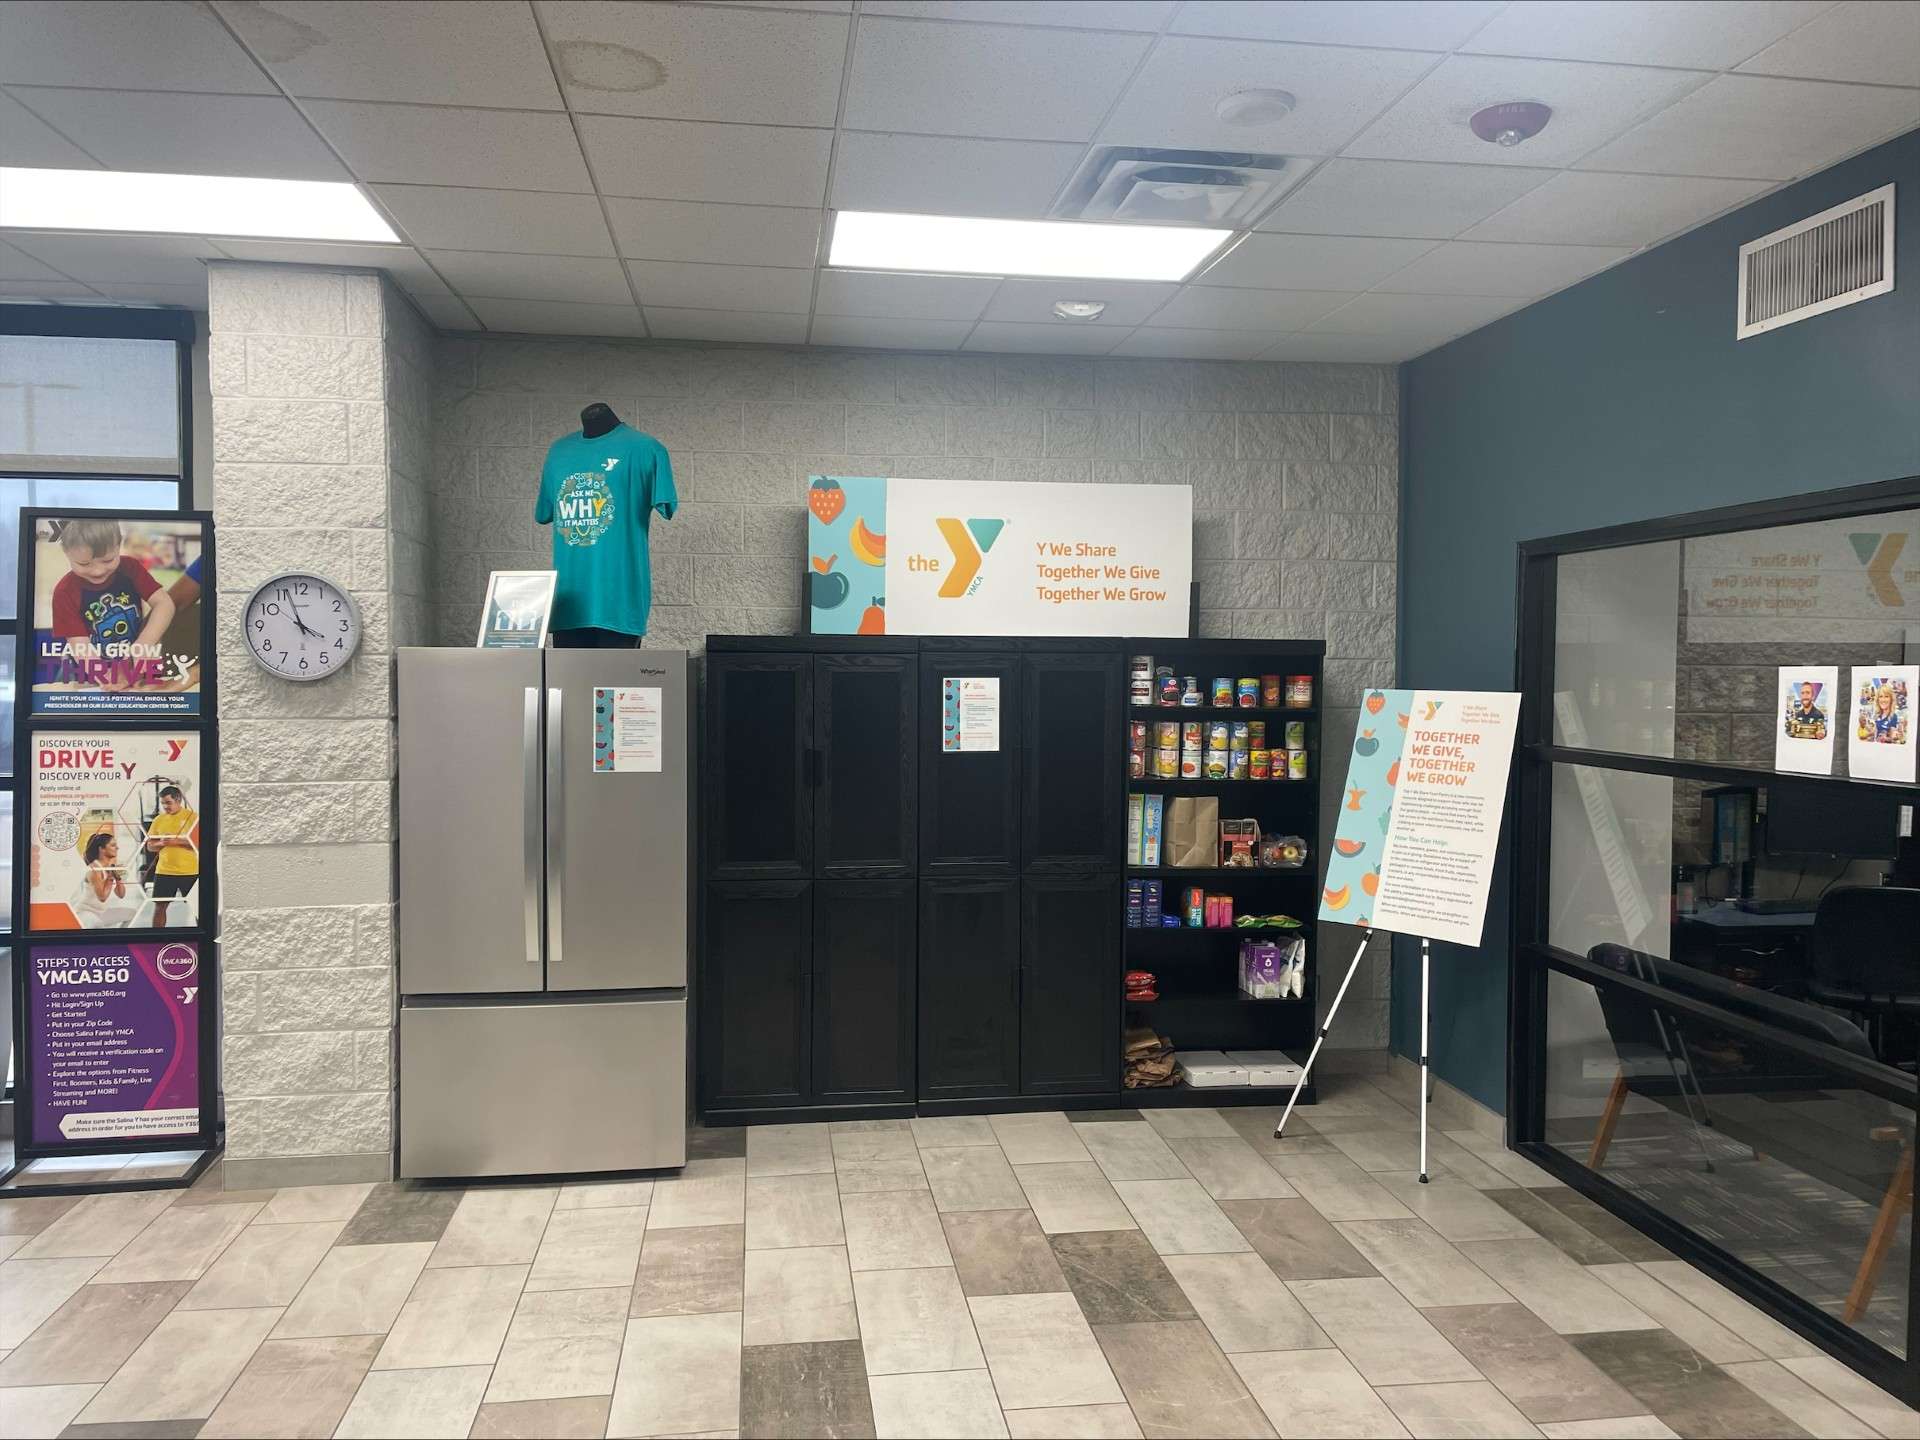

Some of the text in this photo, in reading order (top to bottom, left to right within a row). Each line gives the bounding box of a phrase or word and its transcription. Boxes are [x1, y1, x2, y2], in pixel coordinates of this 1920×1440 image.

[1498, 104, 1527, 114] FIRE
[559, 498, 607, 520] WHY
[1036, 542, 1117, 557] Y We Share
[908, 554, 940, 572] the
[1036, 564, 1160, 582] Together We Give
[294, 582, 308, 595] 12
[966, 576, 984, 596] YMCA
[276, 589, 286, 600] 11
[1036, 586, 1166, 604] Together We Grow
[261, 603, 280, 616] 10
[332, 600, 341, 612] 2
[255, 620, 264, 632] 9
[340, 620, 349, 632] 3
[42, 642, 162, 658] LEARN GROW
[262, 639, 272, 652] 8
[334, 638, 344, 650] 4
[280, 652, 288, 664] 7
[299, 658, 308, 670] 6
[320, 652, 329, 664] 5
[43, 658, 164, 685] THRIVE
[1414, 730, 1480, 744] TOGETHER
[40, 740, 110, 748] DISCOVER YOUR
[1412, 744, 1464, 760] WE GIVE,
[40, 750, 114, 768] DRIVE
[1410, 758, 1476, 772] TOGETHER
[40, 762, 136, 780] DISCOVER YOUR Y
[1407, 771, 1468, 786] WE GROW
[36, 956, 130, 968] STEPS TO ACCESS
[36, 968, 130, 985] YMCA360
[70, 990, 126, 998] www.ymca360.org
[94, 1000, 104, 1008] Up
[86, 1020, 96, 1028] Zip
[94, 1030, 114, 1038] Family
[116, 1028, 134, 1036] YMCA
[105, 1048, 139, 1056] verification
[52, 1070, 76, 1078] Explore
[53, 1090, 84, 1098] Streaming
